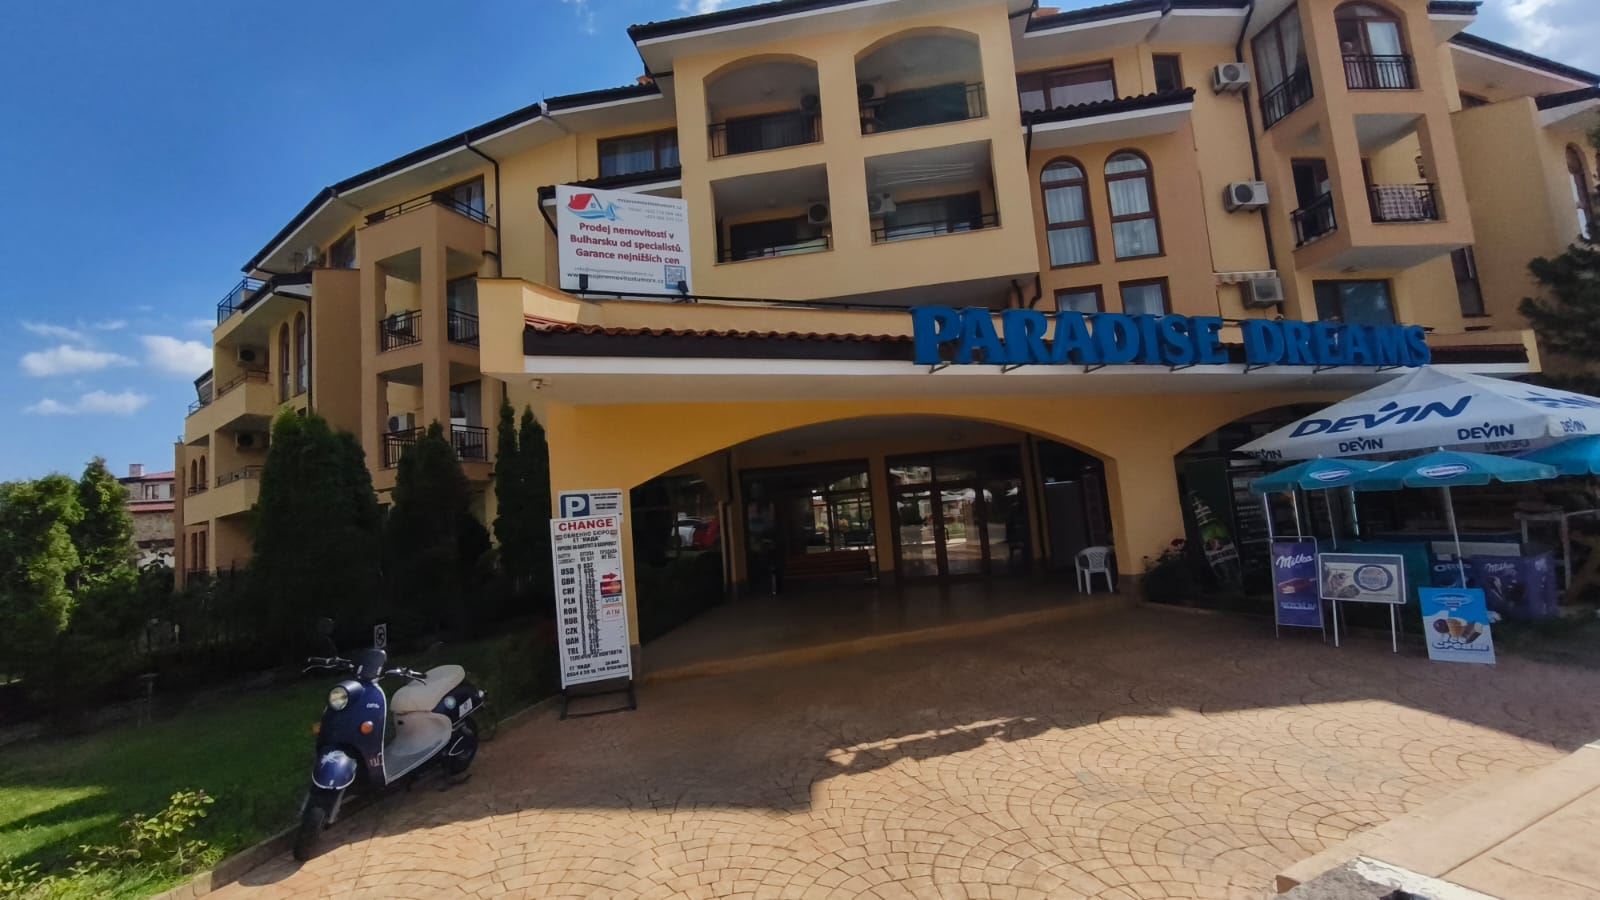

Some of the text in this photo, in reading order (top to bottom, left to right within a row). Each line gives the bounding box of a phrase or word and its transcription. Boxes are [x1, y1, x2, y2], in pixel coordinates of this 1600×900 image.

[579, 222, 611, 235] Prodej
[613, 226, 667, 239] nemovitostí
[570, 234, 684, 253] Bulharsku od specialistů.
[575, 248, 615, 259] Garance
[618, 251, 662, 263] nejnižších
[913, 306, 1431, 367] PARADISE DREAMS
[1288, 395, 1472, 438] DEVIN
[1560, 417, 1587, 432] DEVIN
[1457, 422, 1514, 440] DEVIN
[1338, 436, 1383, 453] DEVIN
[565, 496, 586, 519] P
[558, 518, 614, 532] CHANGE
[1275, 553, 1314, 568] Milka
[1484, 561, 1515, 572] Milka
[564, 607, 577, 615] RON
[566, 627, 578, 635] CZK
